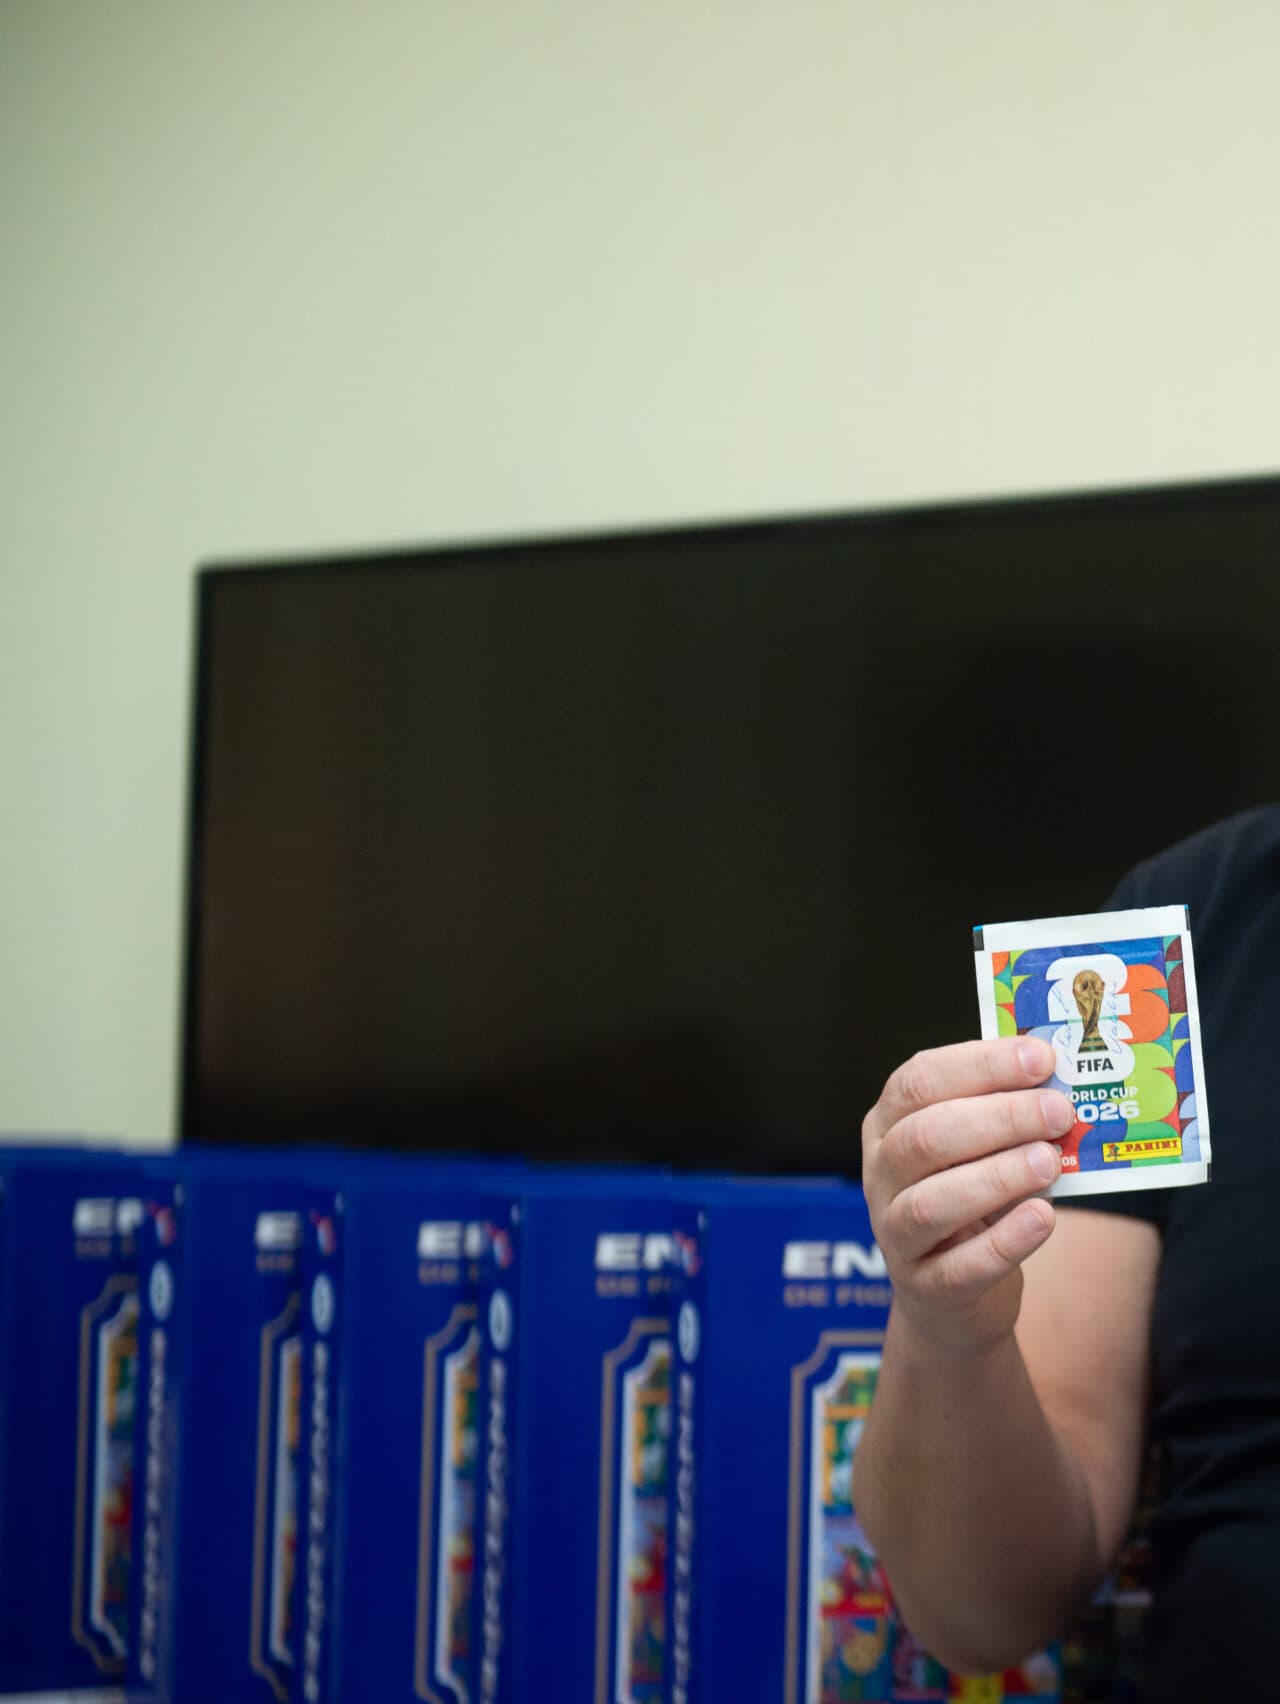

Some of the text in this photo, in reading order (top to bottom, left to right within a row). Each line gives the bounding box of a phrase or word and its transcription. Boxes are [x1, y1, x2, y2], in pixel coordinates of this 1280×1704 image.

[1076, 1056, 1115, 1073] FIFA
[1110, 1085, 1138, 1099] CUP
[1073, 1100, 1140, 1124] 026
[1125, 1138, 1179, 1153] PANINI
